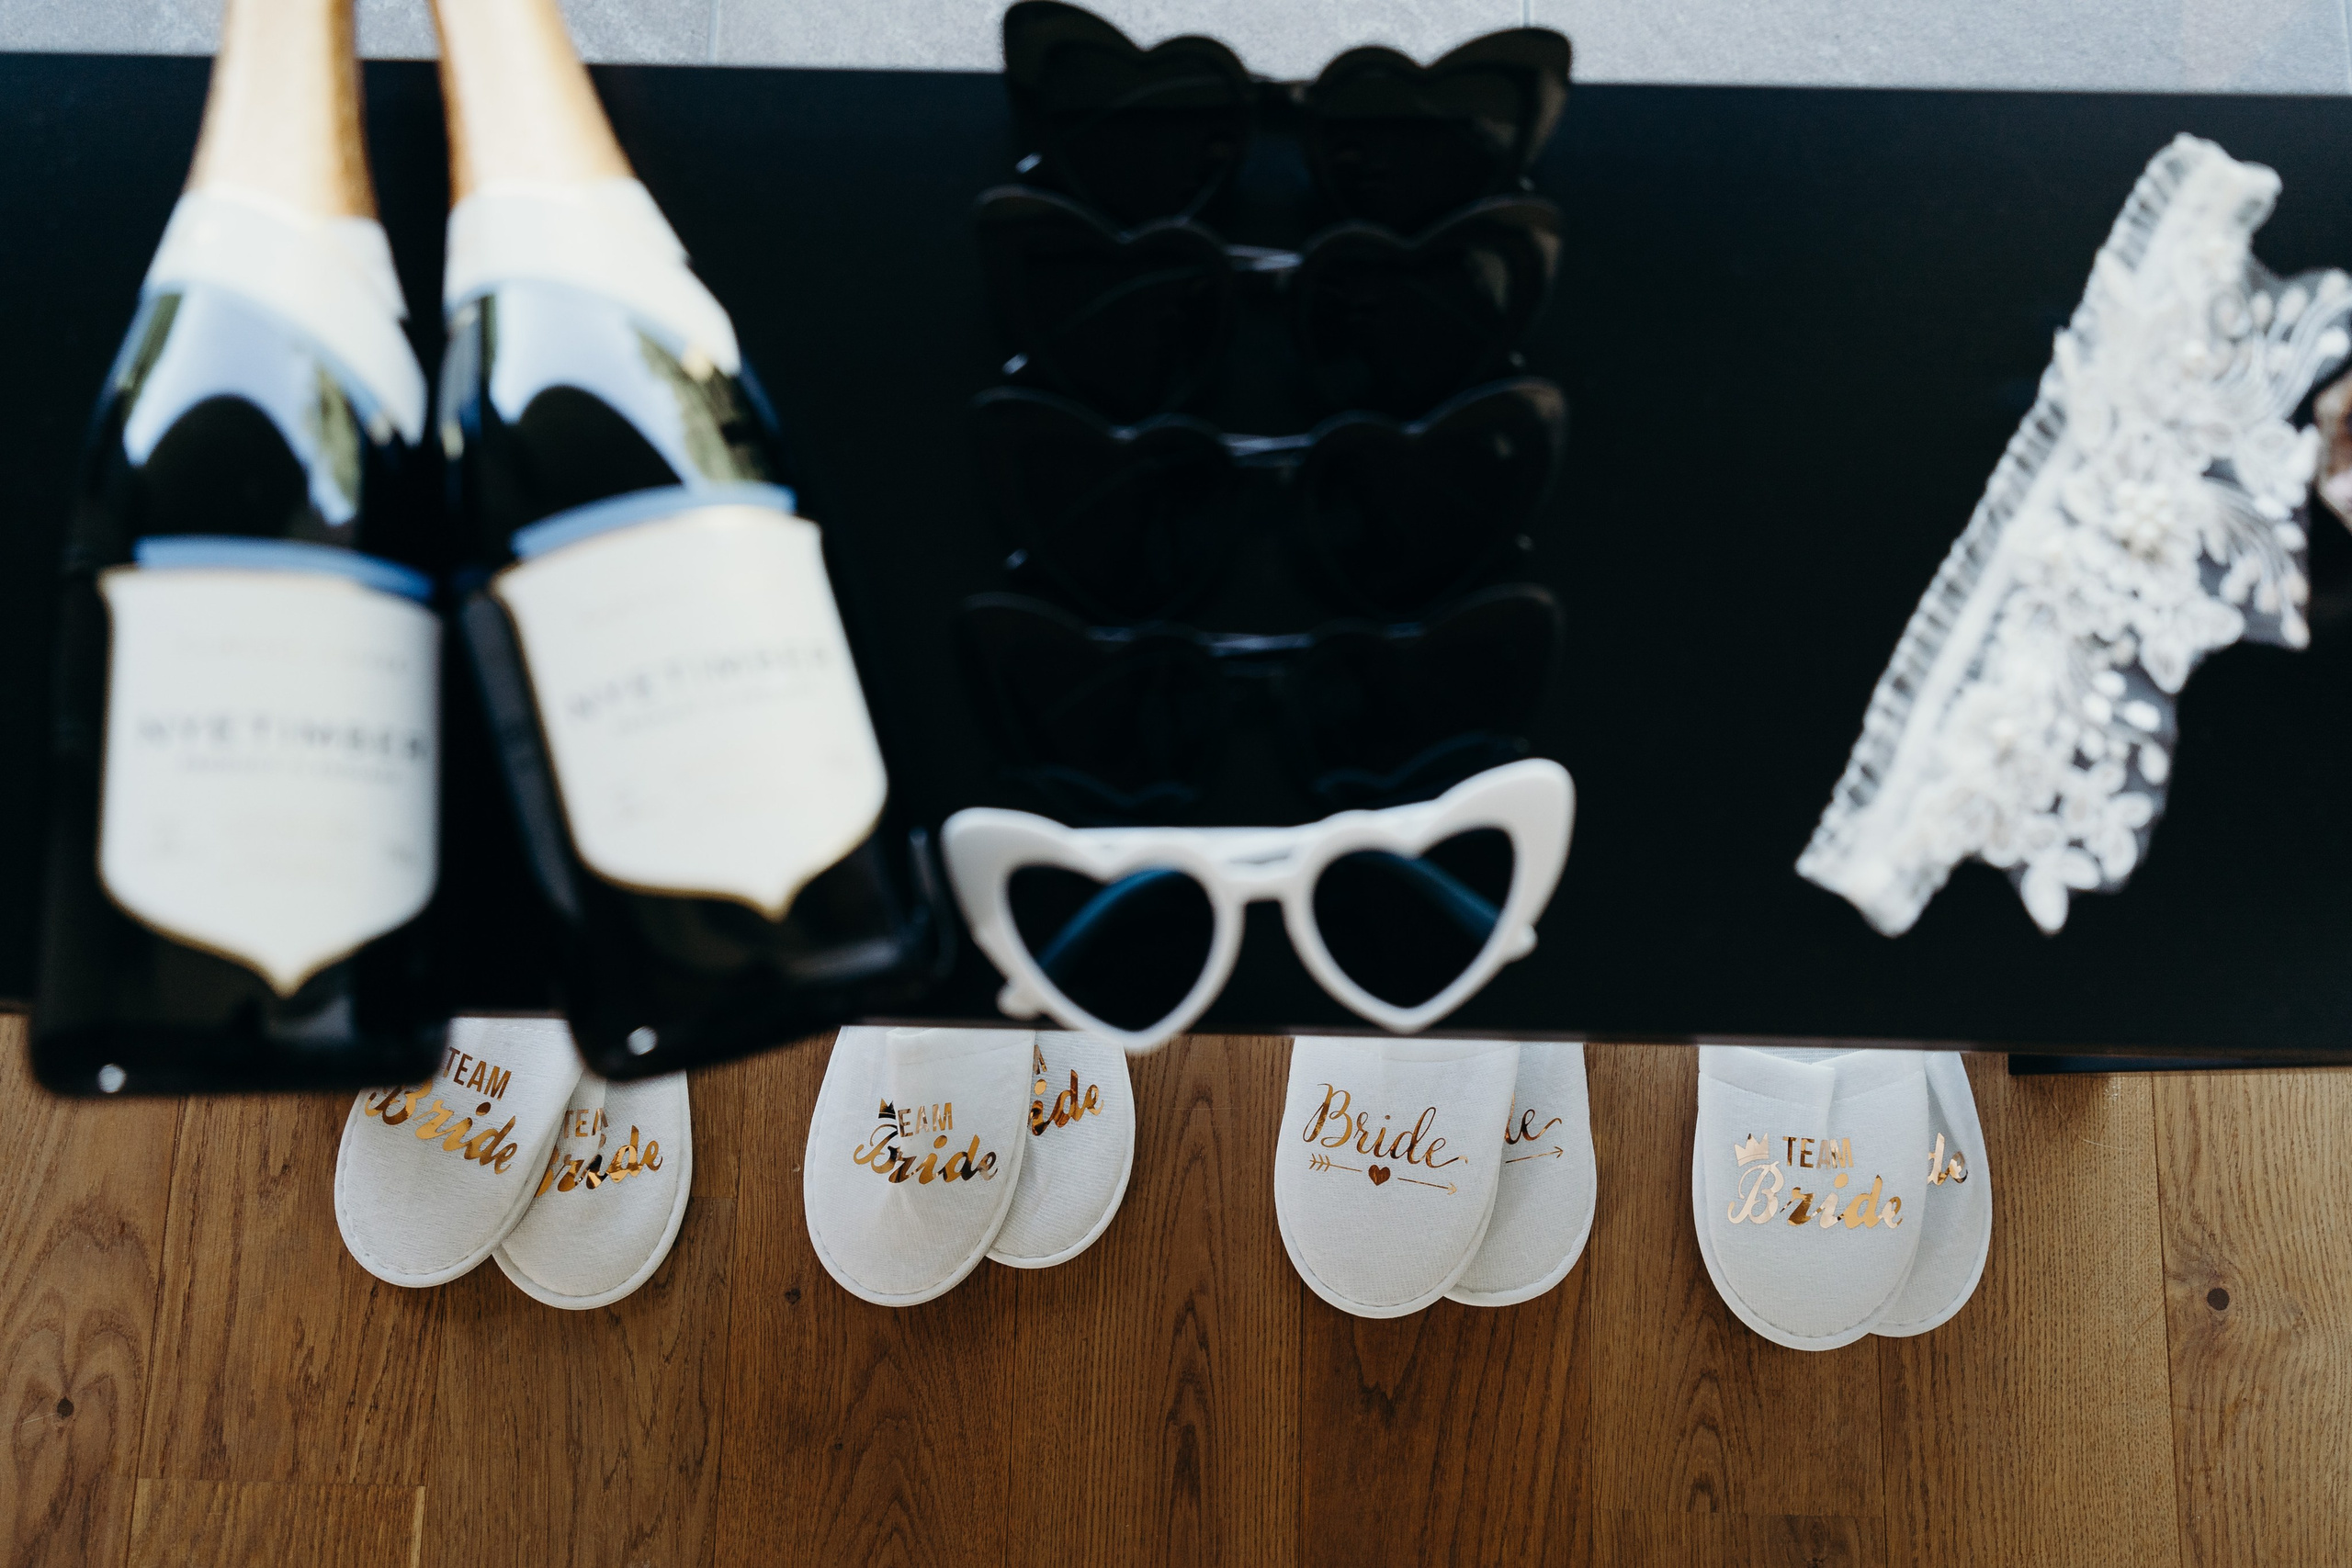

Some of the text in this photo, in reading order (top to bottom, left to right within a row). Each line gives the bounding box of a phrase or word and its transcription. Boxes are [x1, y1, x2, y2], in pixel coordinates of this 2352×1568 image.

[443, 1046, 512, 1100] TEAM
[1027, 1068, 1104, 1136] ide
[897, 1102, 953, 1137] EAM
[1302, 1083, 1468, 1168] Bride
[1782, 1136, 1854, 1169] TEAM
[1727, 1160, 1904, 1229] Bride
